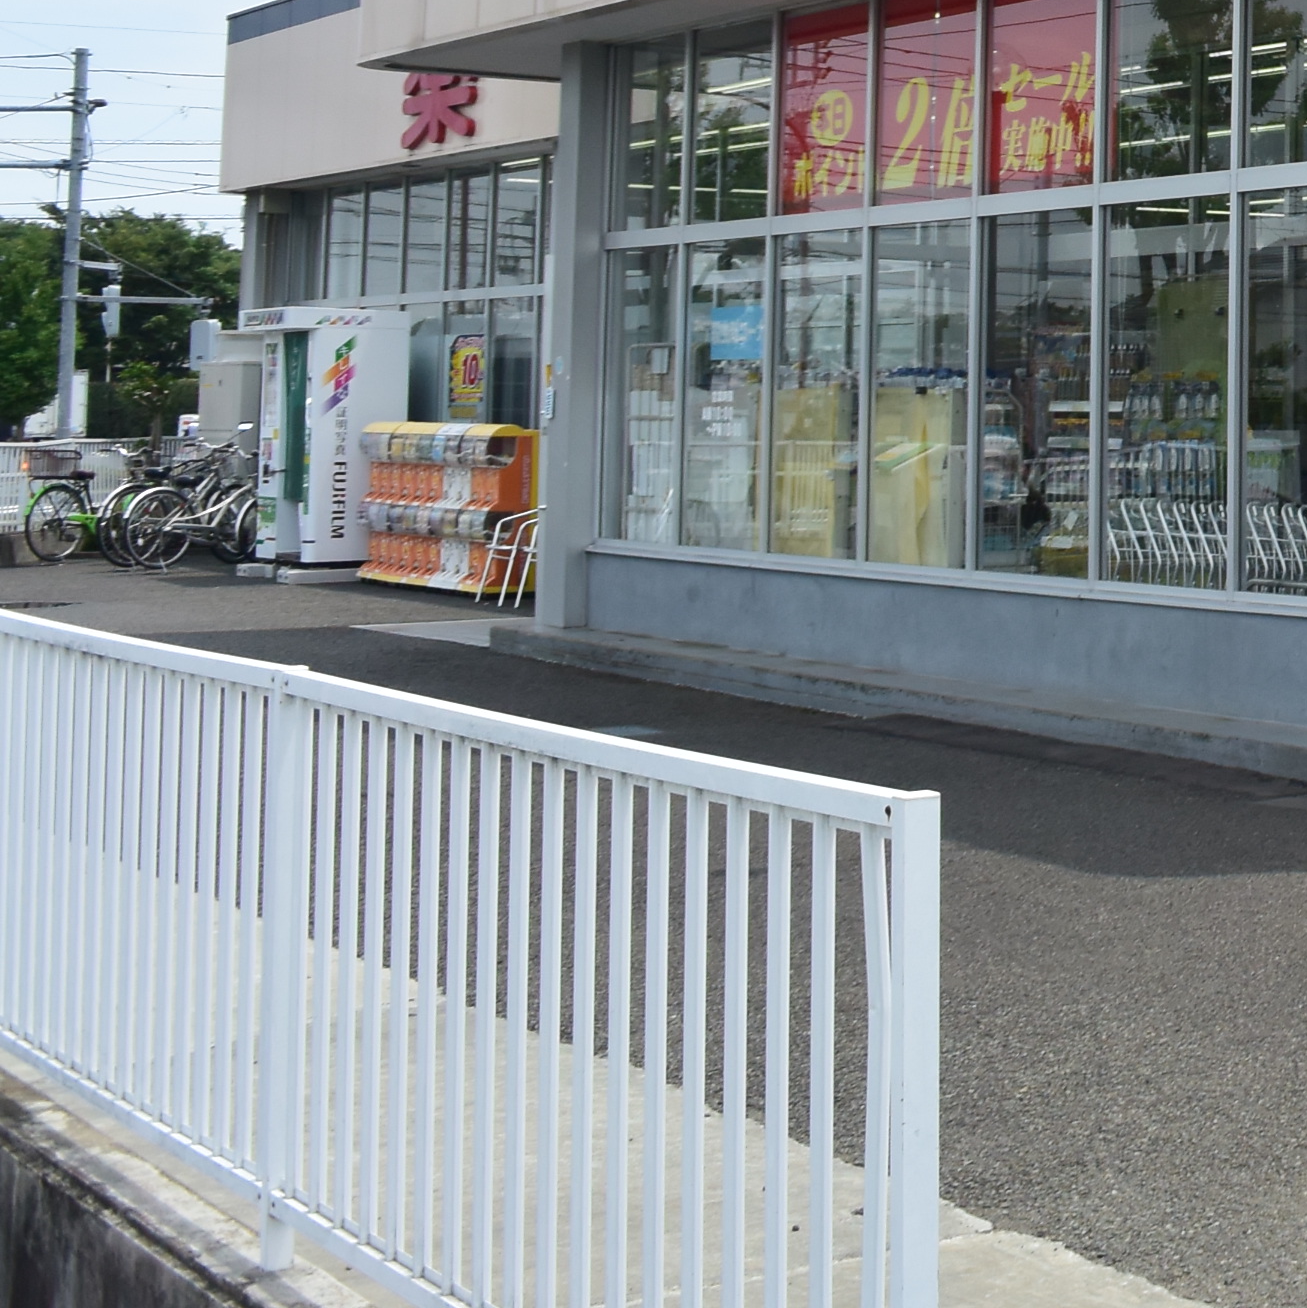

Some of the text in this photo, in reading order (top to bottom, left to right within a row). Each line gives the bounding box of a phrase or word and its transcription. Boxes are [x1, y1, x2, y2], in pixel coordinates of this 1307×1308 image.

[1002, 51, 1095, 112] セール
[330, 461, 348, 540] FUJIFILM
